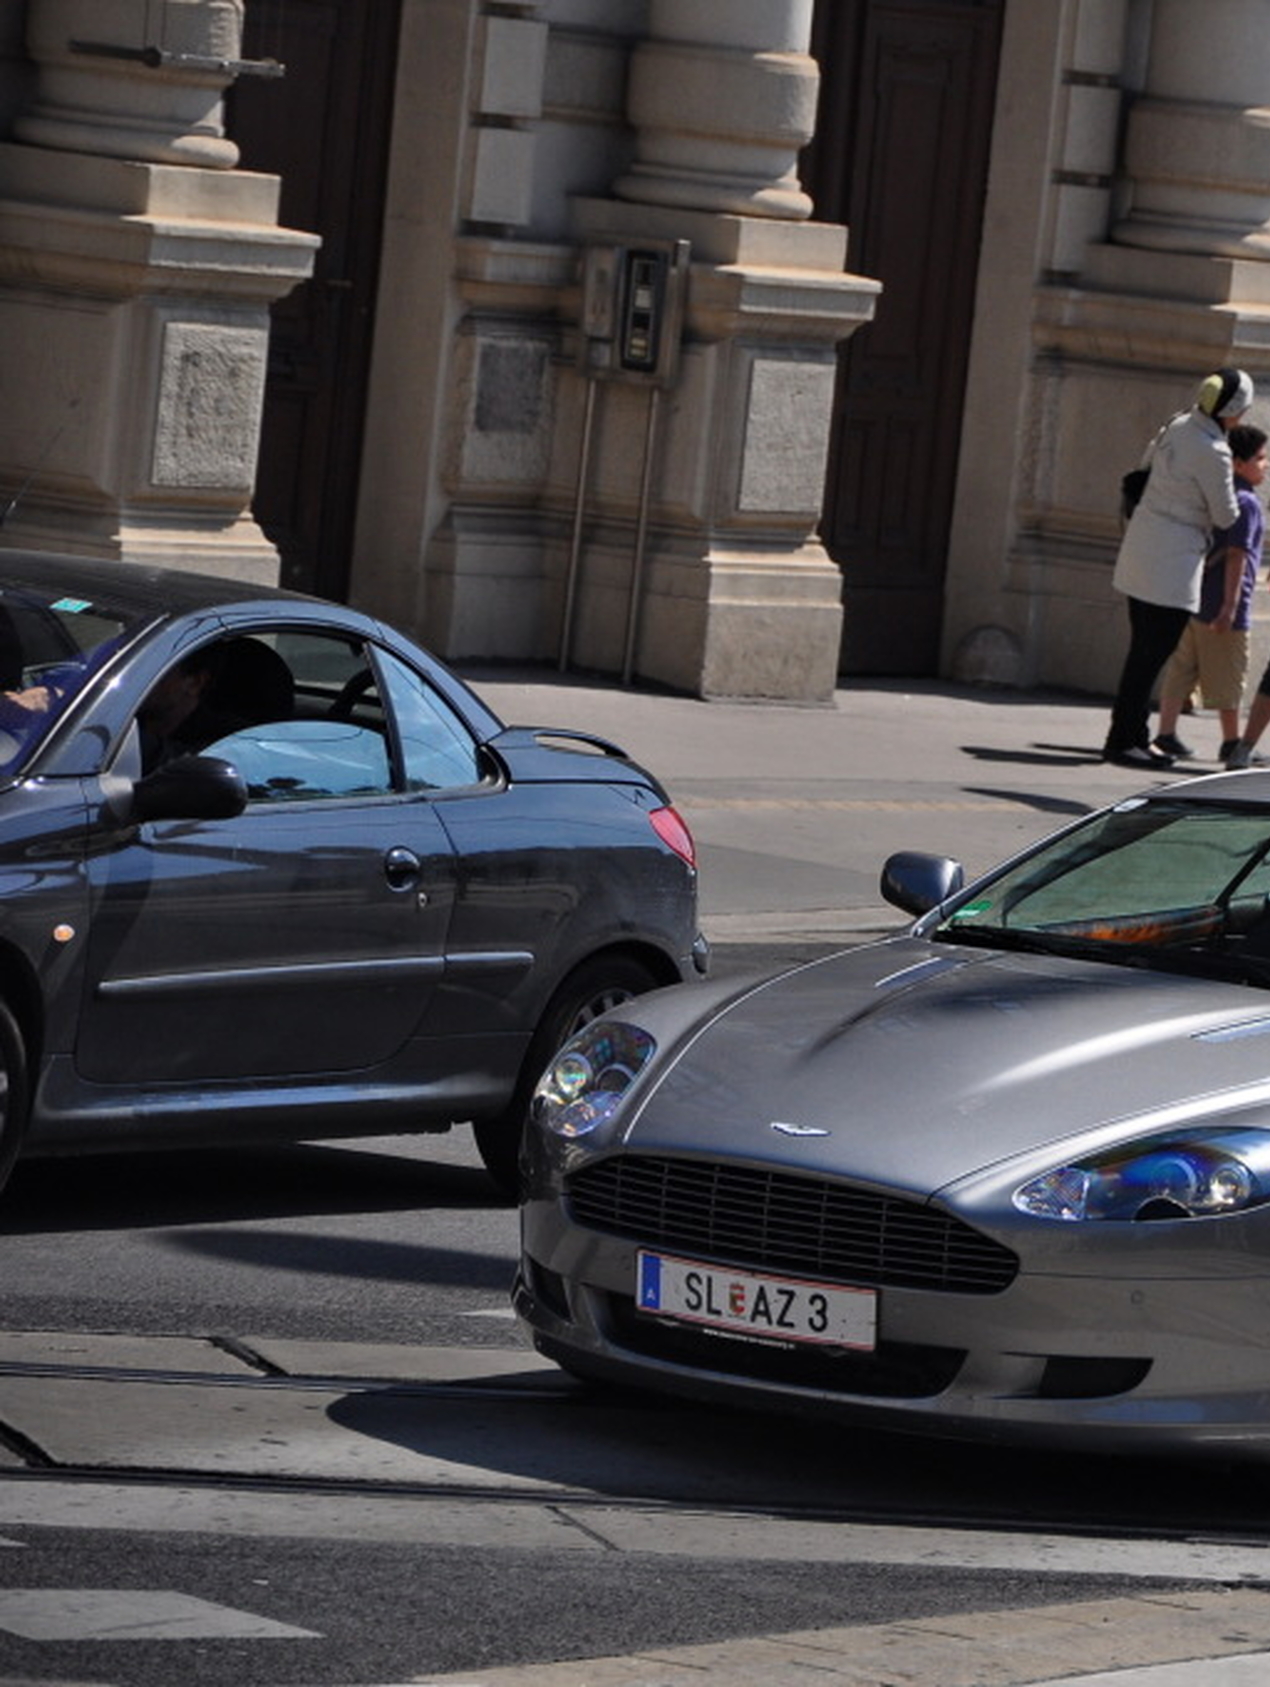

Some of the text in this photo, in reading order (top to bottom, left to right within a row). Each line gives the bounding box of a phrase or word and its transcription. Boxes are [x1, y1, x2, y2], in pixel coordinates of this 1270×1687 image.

[646, 1288, 656, 1300] A
[685, 1271, 828, 1333] SL AZ 3
